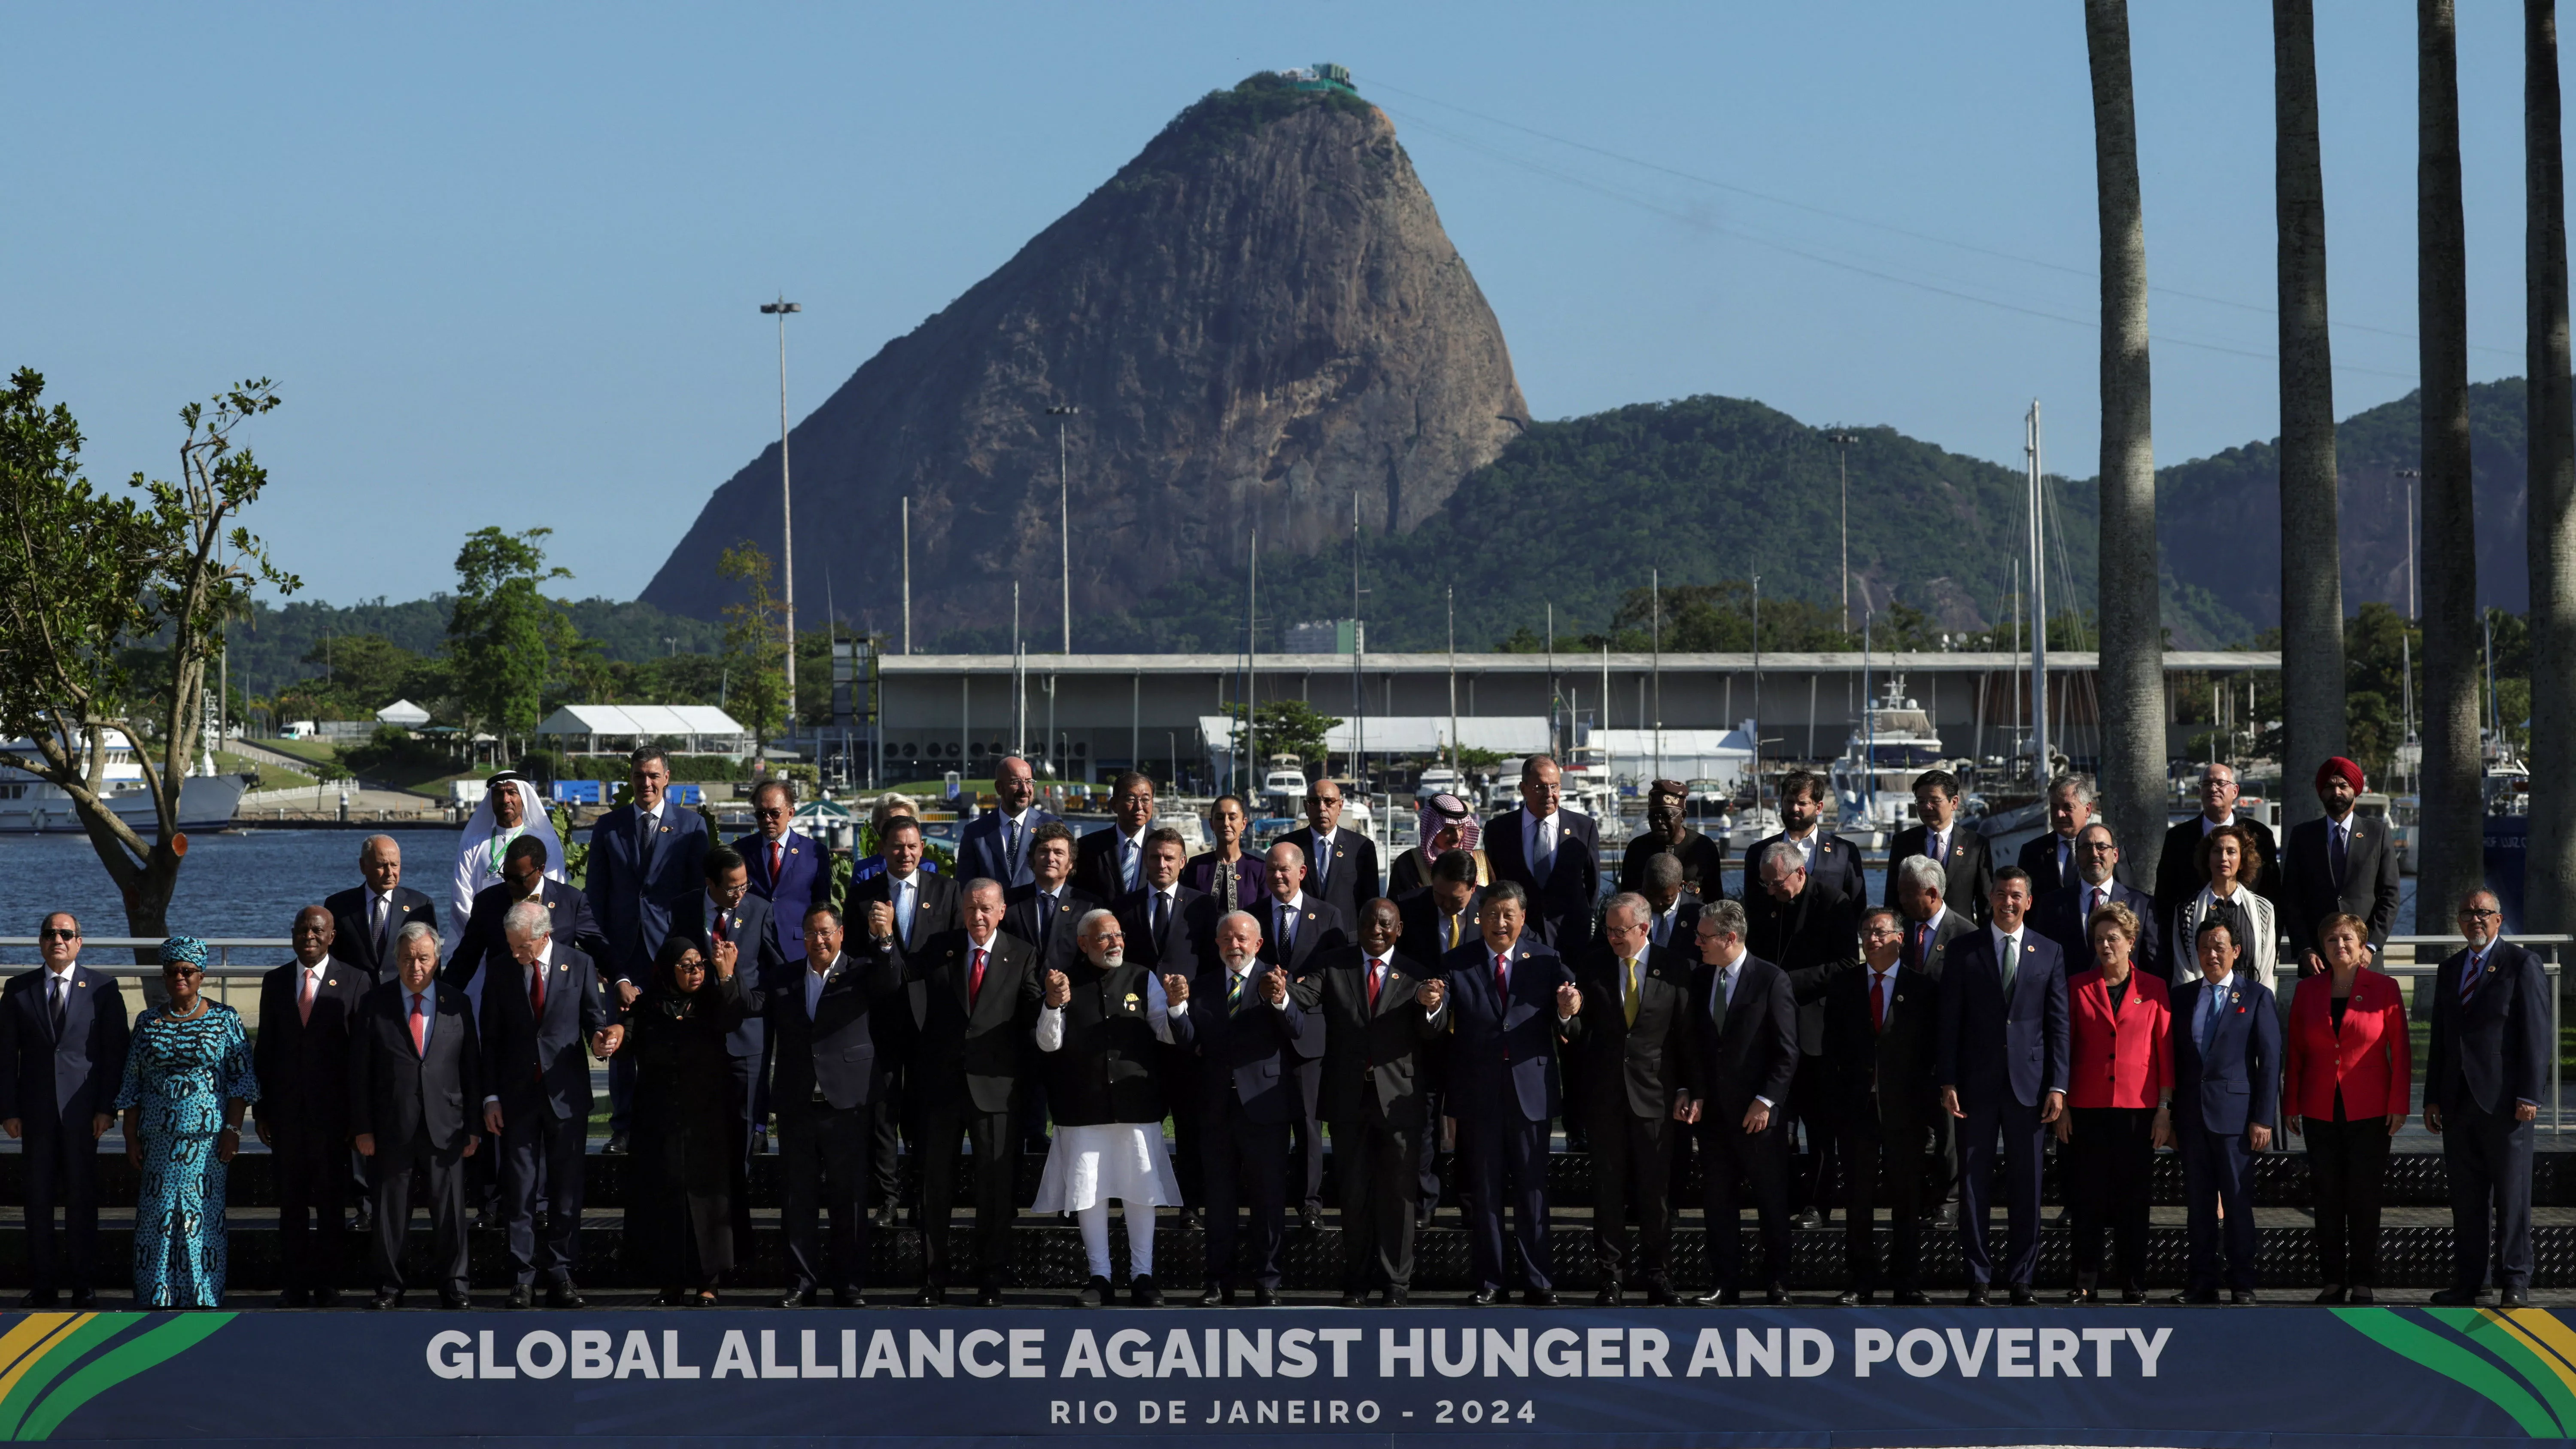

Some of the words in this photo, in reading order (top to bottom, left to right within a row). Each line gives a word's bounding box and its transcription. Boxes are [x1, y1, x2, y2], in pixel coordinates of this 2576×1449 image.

[427, 1330, 700, 1379] GLOBAL
[711, 1329, 1045, 1378] ALLIANCE
[1060, 1329, 1361, 1377] AGAINST
[1380, 1328, 1672, 1377] HUNGER
[1686, 1328, 1834, 1377] AND
[1855, 1328, 2173, 1377] POVERTY
[1051, 1401, 1117, 1423] RIO
[1140, 1401, 1186, 1423] DE
[1206, 1400, 1380, 1423] JANEIRO
[1436, 1400, 1535, 1423] 2024
